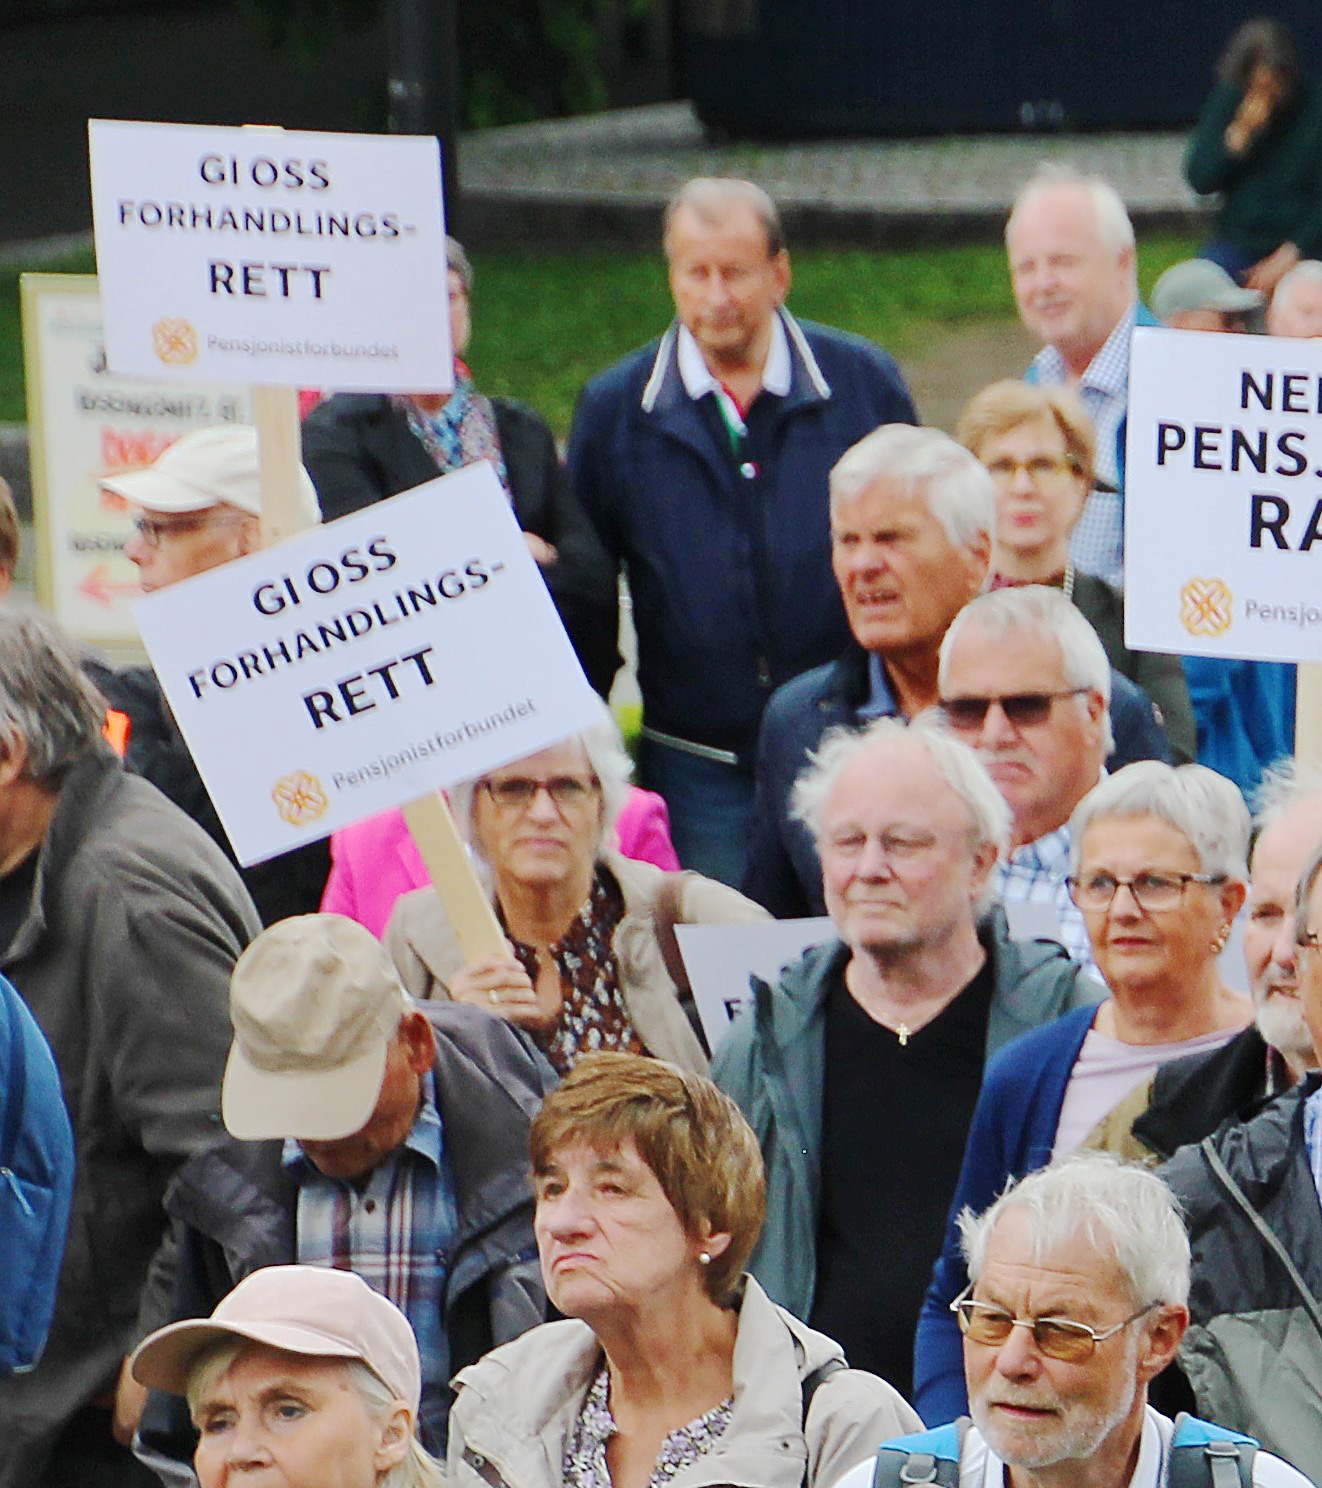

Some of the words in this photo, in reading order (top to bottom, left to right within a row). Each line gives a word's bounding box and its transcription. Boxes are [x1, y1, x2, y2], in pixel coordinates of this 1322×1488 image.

[200, 154, 238, 186] GI
[252, 158, 330, 190] OSS
[118, 201, 417, 238] FORHANDLINGS-
[209, 259, 330, 299] RETT
[207, 333, 400, 364] Pensjonistforbundet
[253, 573, 302, 617] GI
[307, 536, 398, 594] OSS
[188, 559, 505, 698] FORHANDLINGS-
[303, 644, 436, 730] RETT
[332, 699, 537, 791] Pensjonistforbundet
